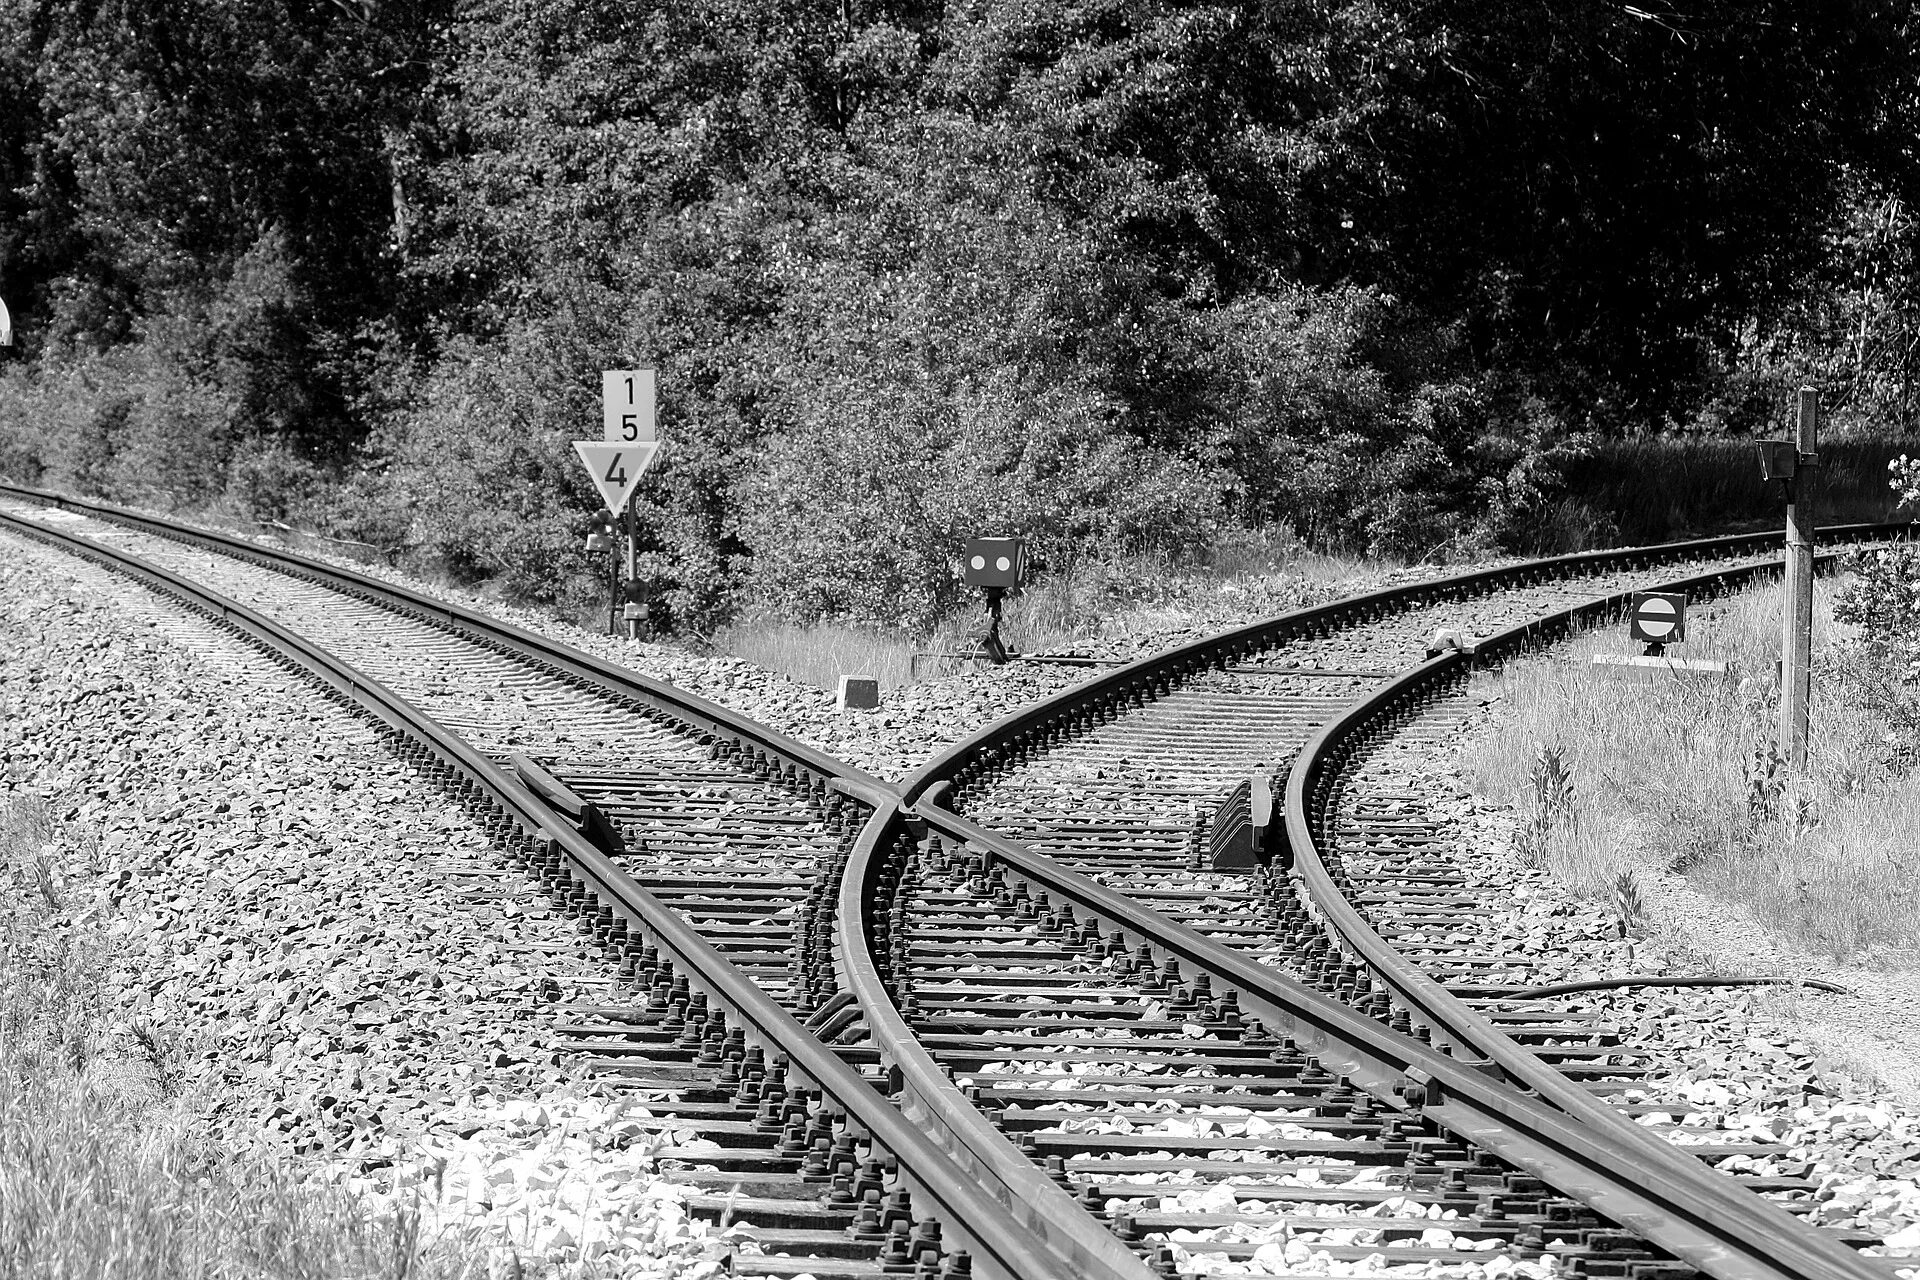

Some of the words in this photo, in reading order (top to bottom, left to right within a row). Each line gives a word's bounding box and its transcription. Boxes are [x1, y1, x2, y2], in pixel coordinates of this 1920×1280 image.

[624, 377, 634, 405] 1
[622, 414, 638, 441] 5
[604, 452, 628, 488] 4
